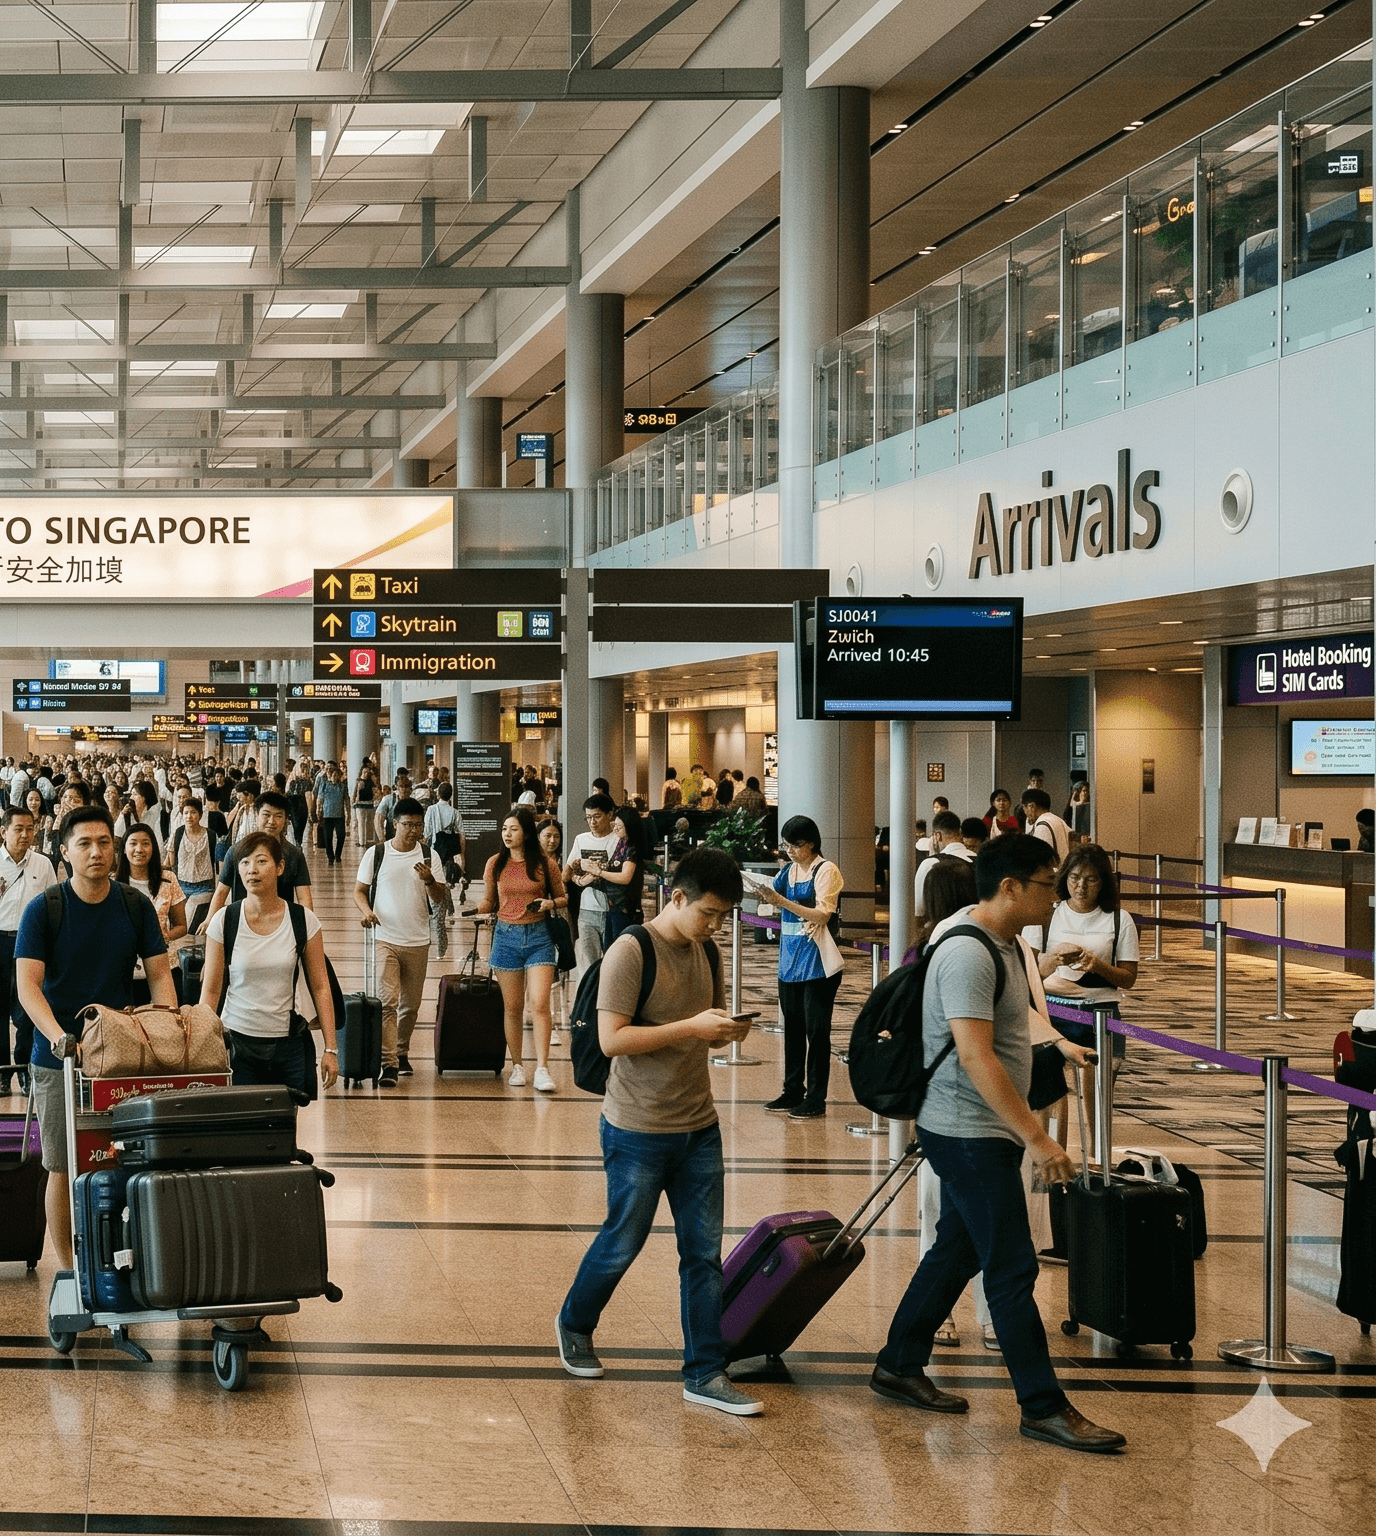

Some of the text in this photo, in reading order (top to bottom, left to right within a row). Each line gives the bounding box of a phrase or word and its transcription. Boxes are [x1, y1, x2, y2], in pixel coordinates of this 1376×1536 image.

[968, 448, 1162, 580] Arrivals
[45, 516, 251, 545] SINGAPORE
[380, 576, 419, 595] Taxi
[381, 614, 457, 637] Skytrain
[828, 609, 877, 623] SJ0041
[381, 653, 496, 675] Immigration
[827, 648, 930, 662] Arrived 10:45
[1282, 643, 1372, 668] Hotel Booking
[1282, 669, 1344, 692] SIM Cards
